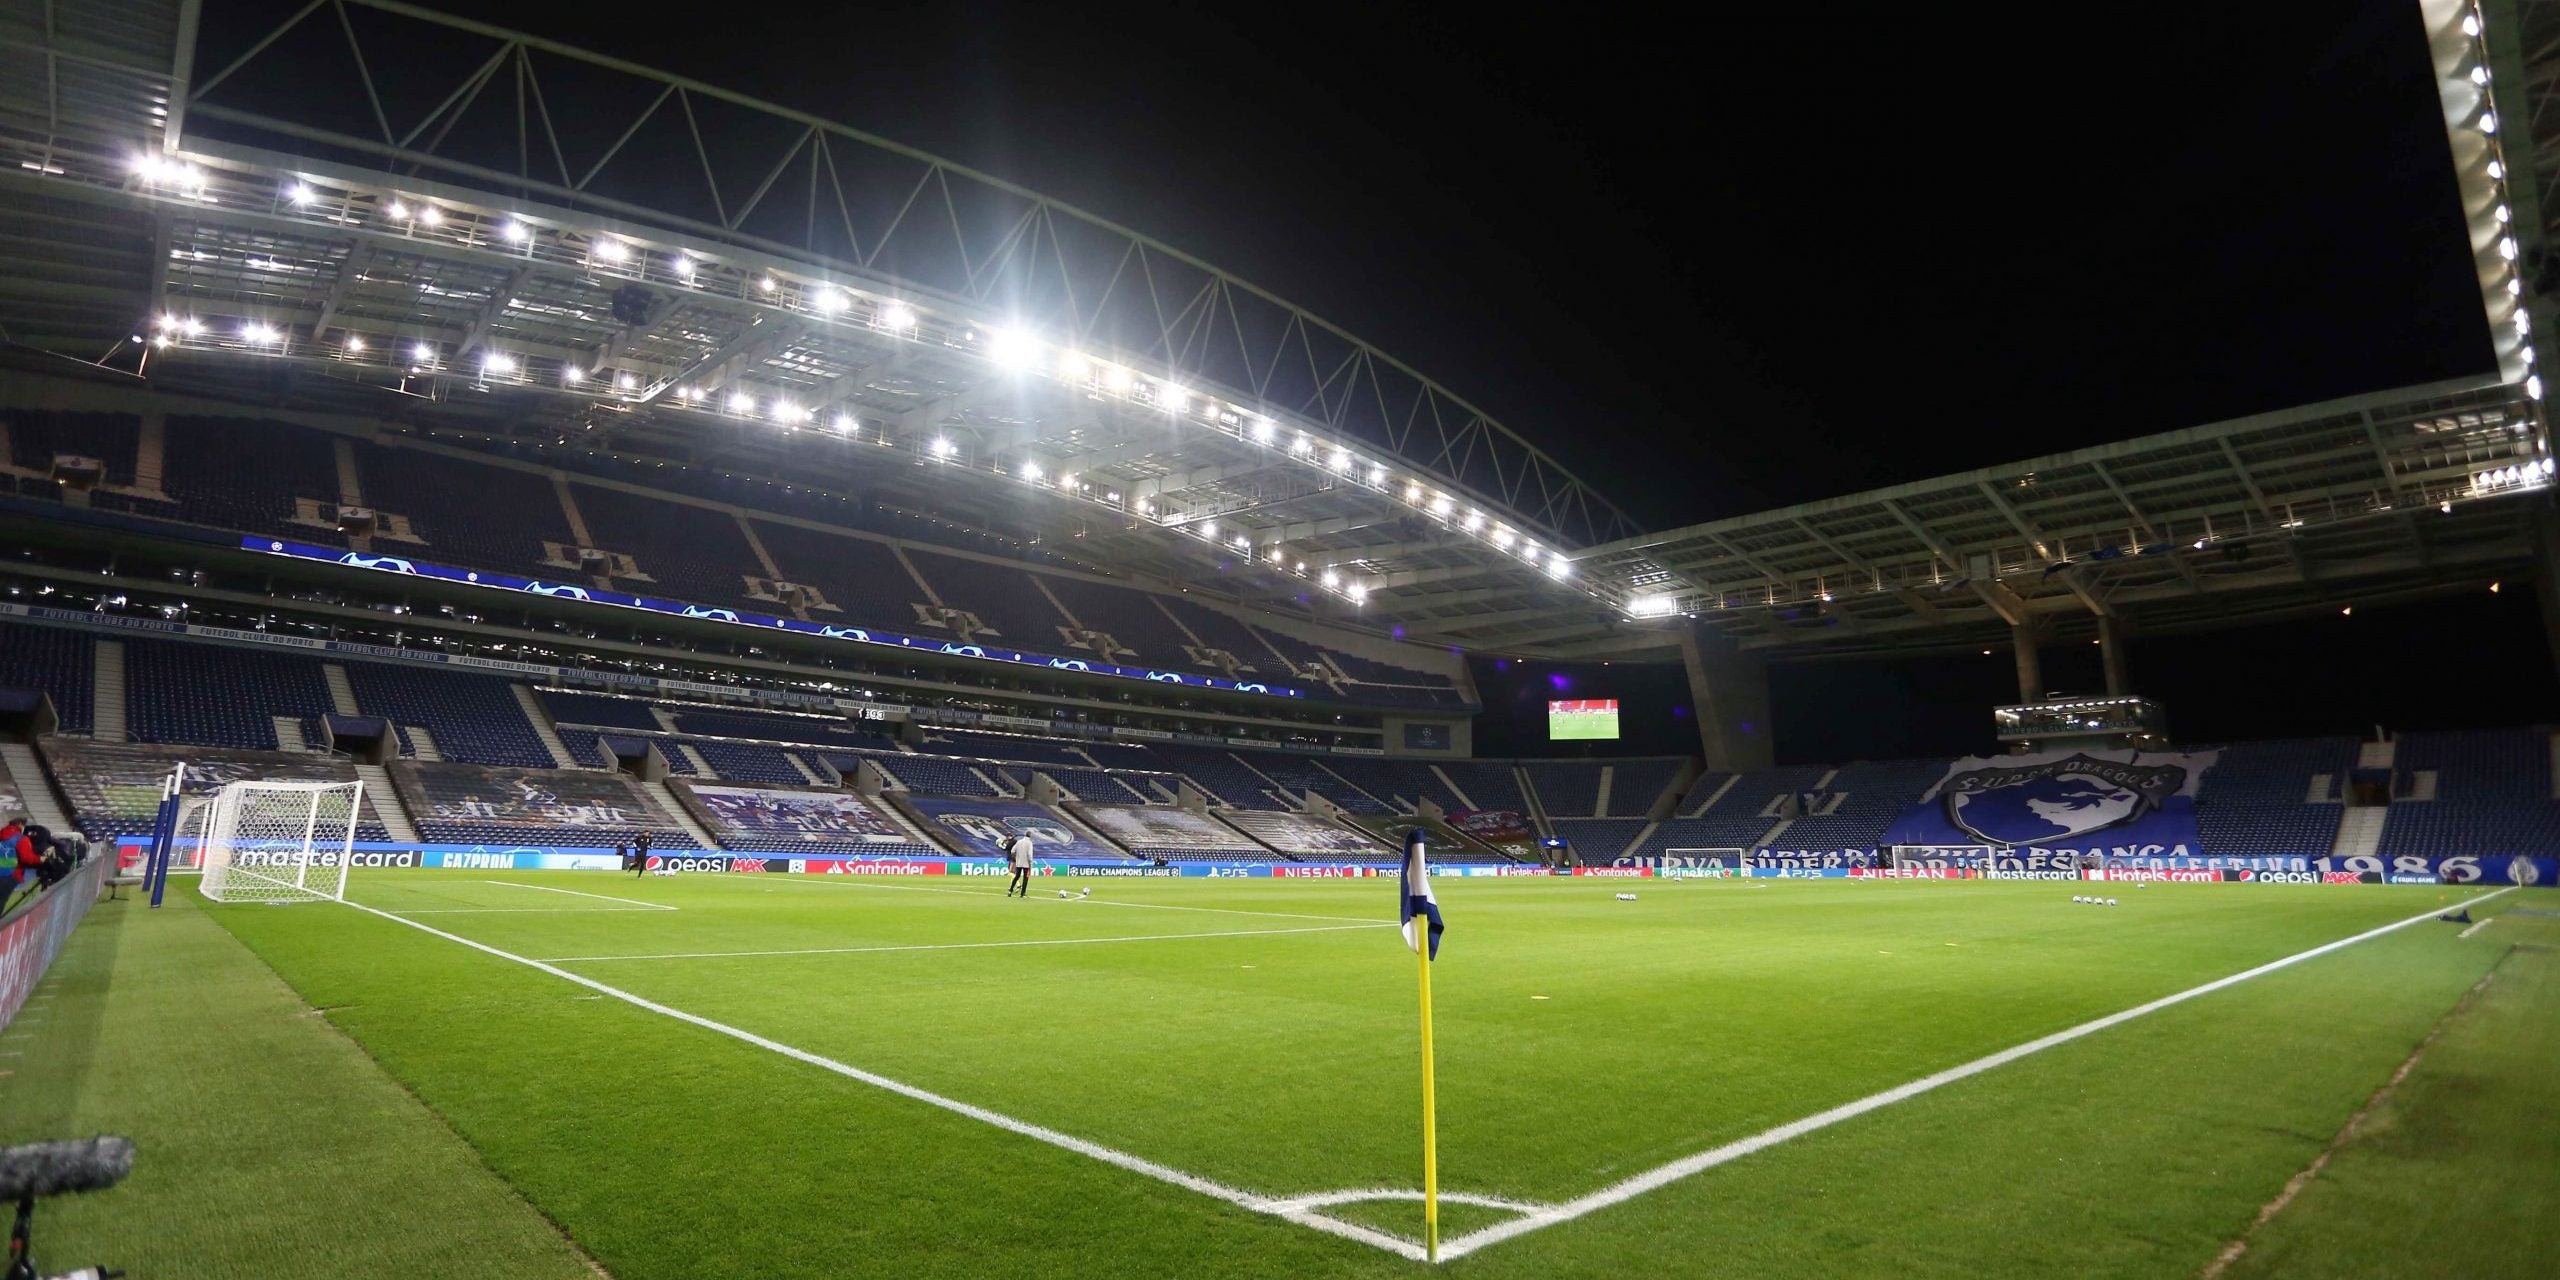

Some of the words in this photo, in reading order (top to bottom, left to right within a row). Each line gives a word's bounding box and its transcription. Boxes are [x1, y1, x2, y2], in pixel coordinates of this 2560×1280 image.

[200, 627, 240, 639] FUTEBOL
[243, 630, 270, 641] CLUBE
[273, 635, 284, 643] DO
[287, 637, 314, 647] PORTO
[337, 642, 371, 654] FUTEBOL
[374, 646, 398, 656] CLUBE
[413, 651, 439, 661] PORTO
[459, 657, 491, 666] FUTEBOL
[493, 660, 515, 669] CLUBE
[528, 664, 550, 673] PORTO
[442, 852, 515, 868] GAZPROM
[668, 857, 727, 872] pepsi
[730, 858, 769, 872] MAX
[845, 861, 926, 875] Santander
[1080, 868, 1100, 876] UEFA
[1101, 868, 1143, 876] CHAMPIONS
[1145, 868, 1170, 877] LEAGUE
[1222, 868, 1249, 878] PS5
[1286, 868, 1344, 878] NISSAN
[1510, 868, 1550, 877] Hotels.com
[1594, 867, 1643, 877] Santander
[1661, 867, 1722, 878] Heineken
[1792, 869, 1822, 878] PS5
[1863, 869, 1946, 879] NISSAN
[1987, 869, 2077, 880] mastercard
[2110, 869, 2211, 881] Hotels.com
[2259, 871, 2318, 883] pepsi
[2322, 871, 2362, 884] MAX
